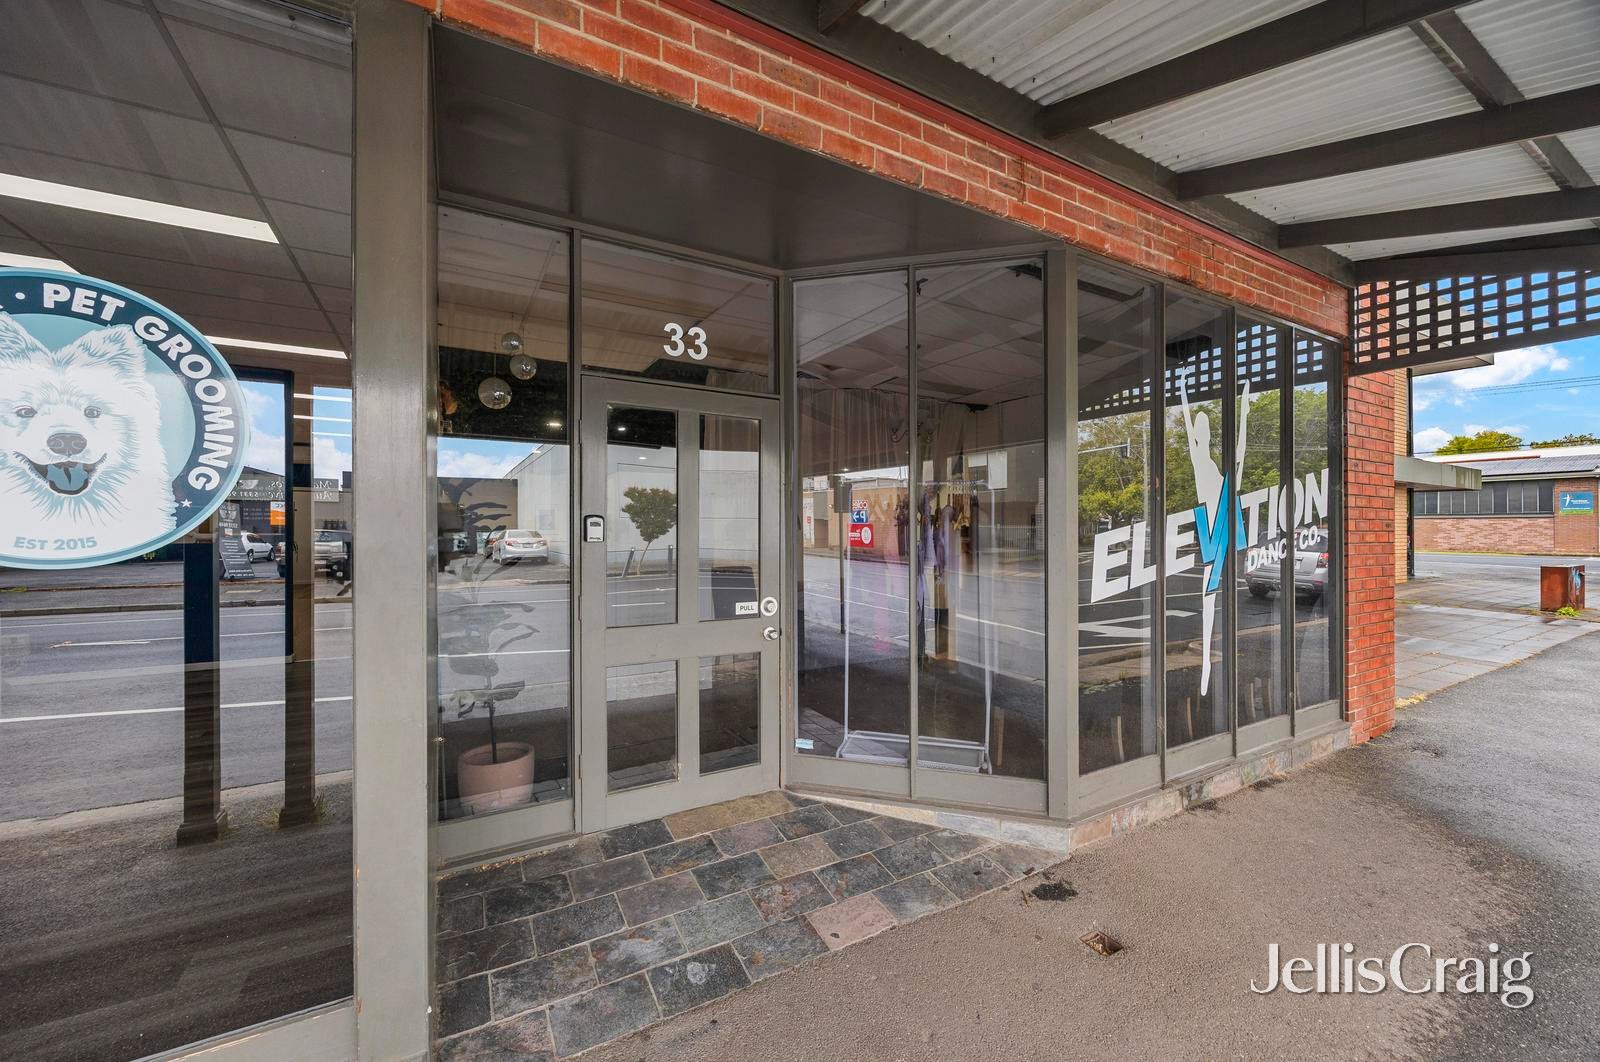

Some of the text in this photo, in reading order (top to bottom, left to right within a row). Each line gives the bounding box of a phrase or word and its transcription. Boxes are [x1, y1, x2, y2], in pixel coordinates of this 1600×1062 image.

[663, 321, 709, 361] 33
[43, 283, 236, 491] PET GROOMING
[14, 536, 98, 550] EST 2015
[1299, 525, 1321, 550] CO.
